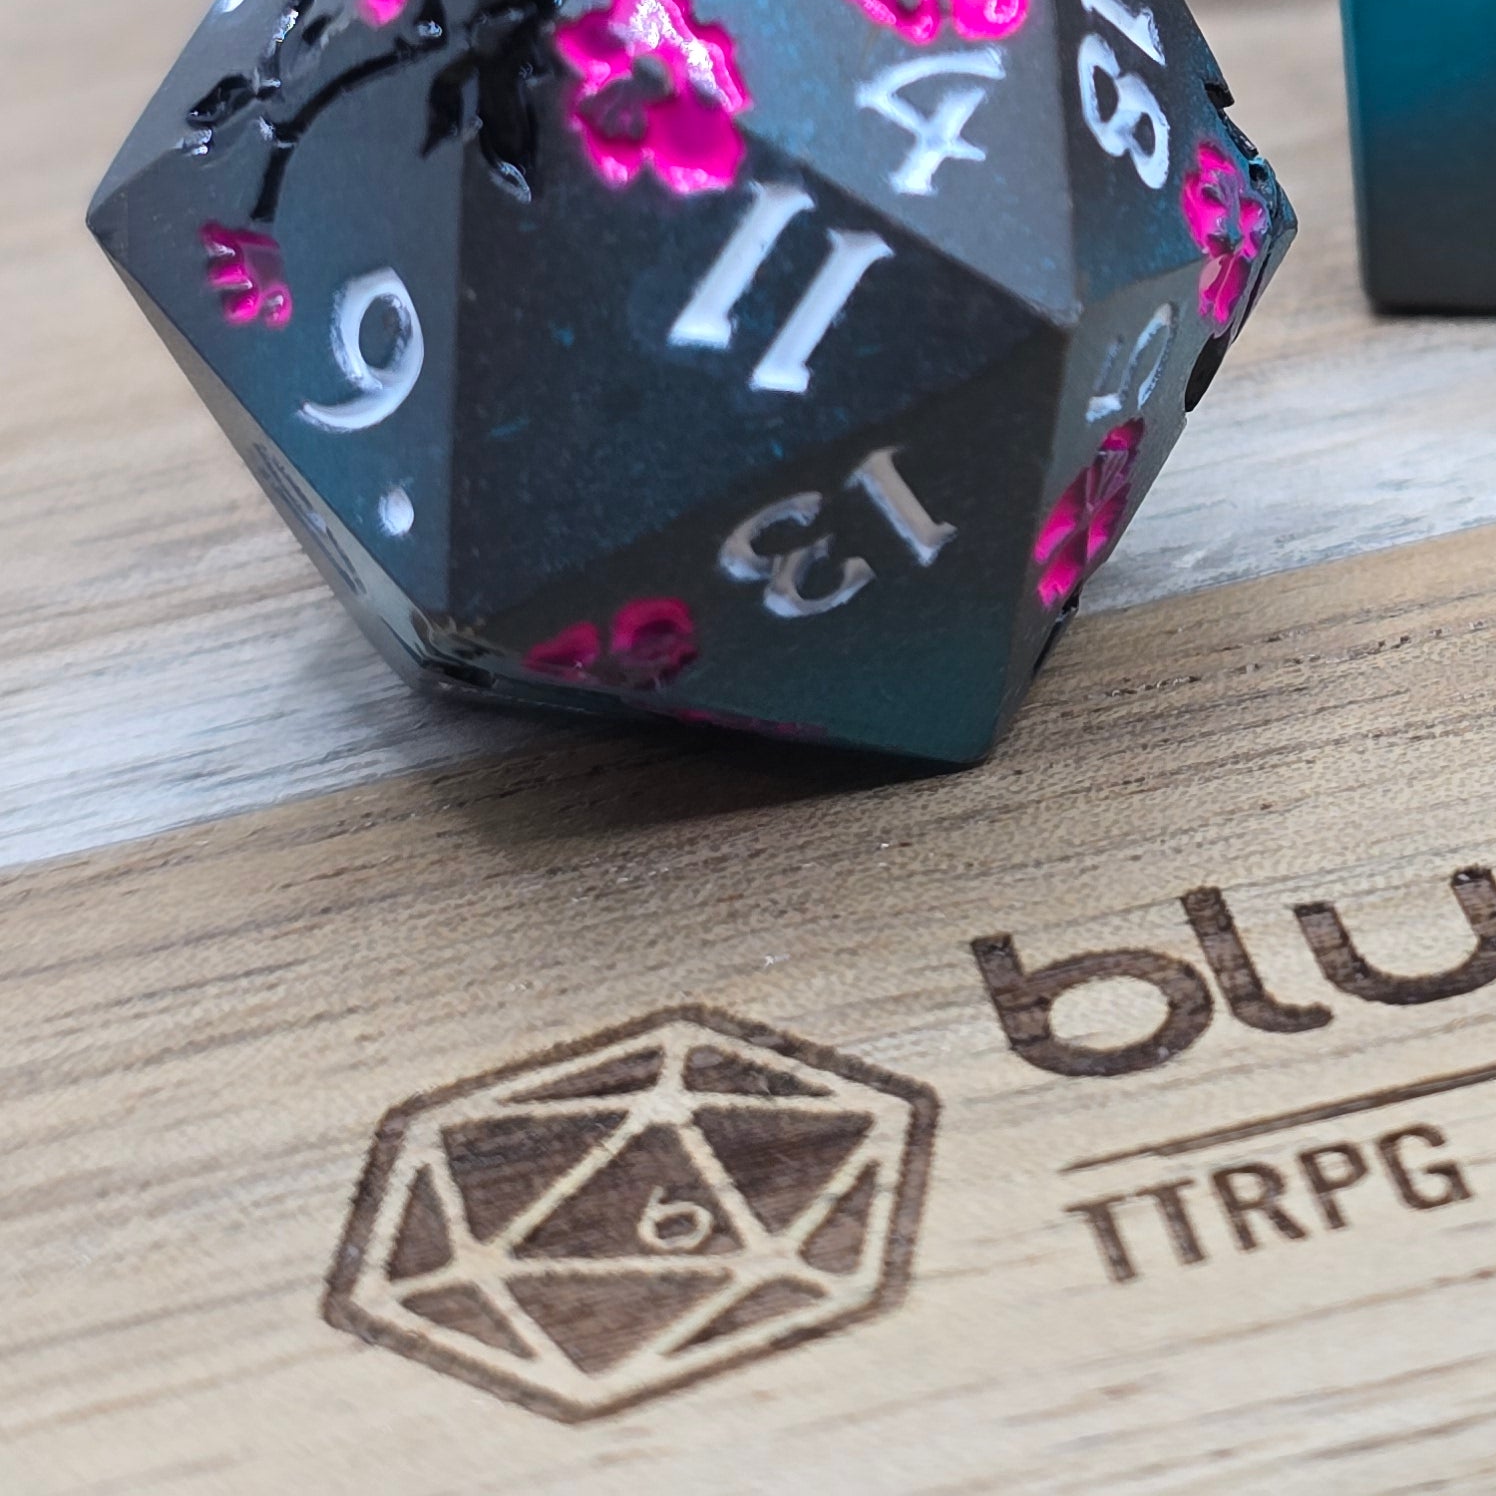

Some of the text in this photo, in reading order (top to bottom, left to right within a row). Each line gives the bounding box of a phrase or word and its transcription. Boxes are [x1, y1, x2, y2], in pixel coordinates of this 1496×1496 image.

[854, 46, 1008, 198] 4
[666, 178, 896, 394] 11
[716, 444, 960, 622] 13
[638, 1186, 714, 1252] 6
[1064, 1120, 1472, 1284] TTRPG
